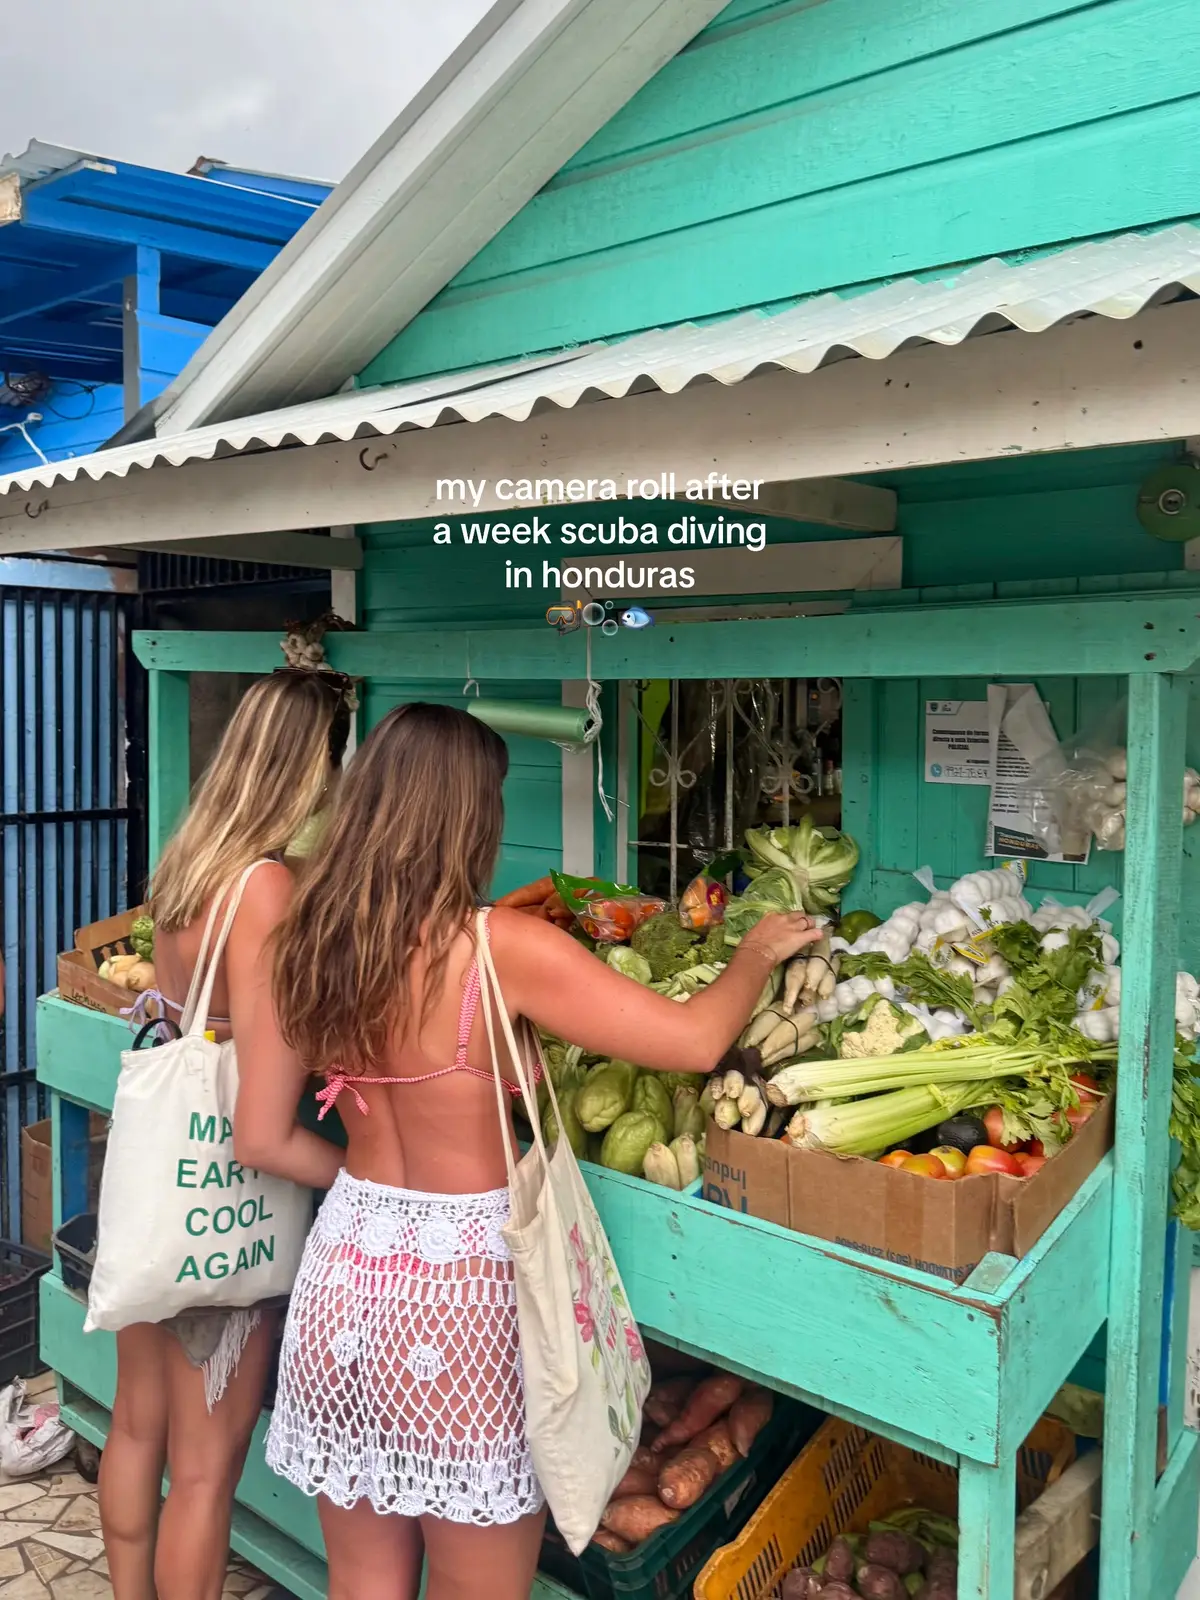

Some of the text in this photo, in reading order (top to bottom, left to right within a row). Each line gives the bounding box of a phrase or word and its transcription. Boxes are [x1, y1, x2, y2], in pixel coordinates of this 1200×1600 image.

[189, 1112, 233, 1144] MA
[176, 1158, 260, 1189] EAR
[185, 1195, 273, 1236] COOL
[175, 1235, 275, 1283] AGAIN
